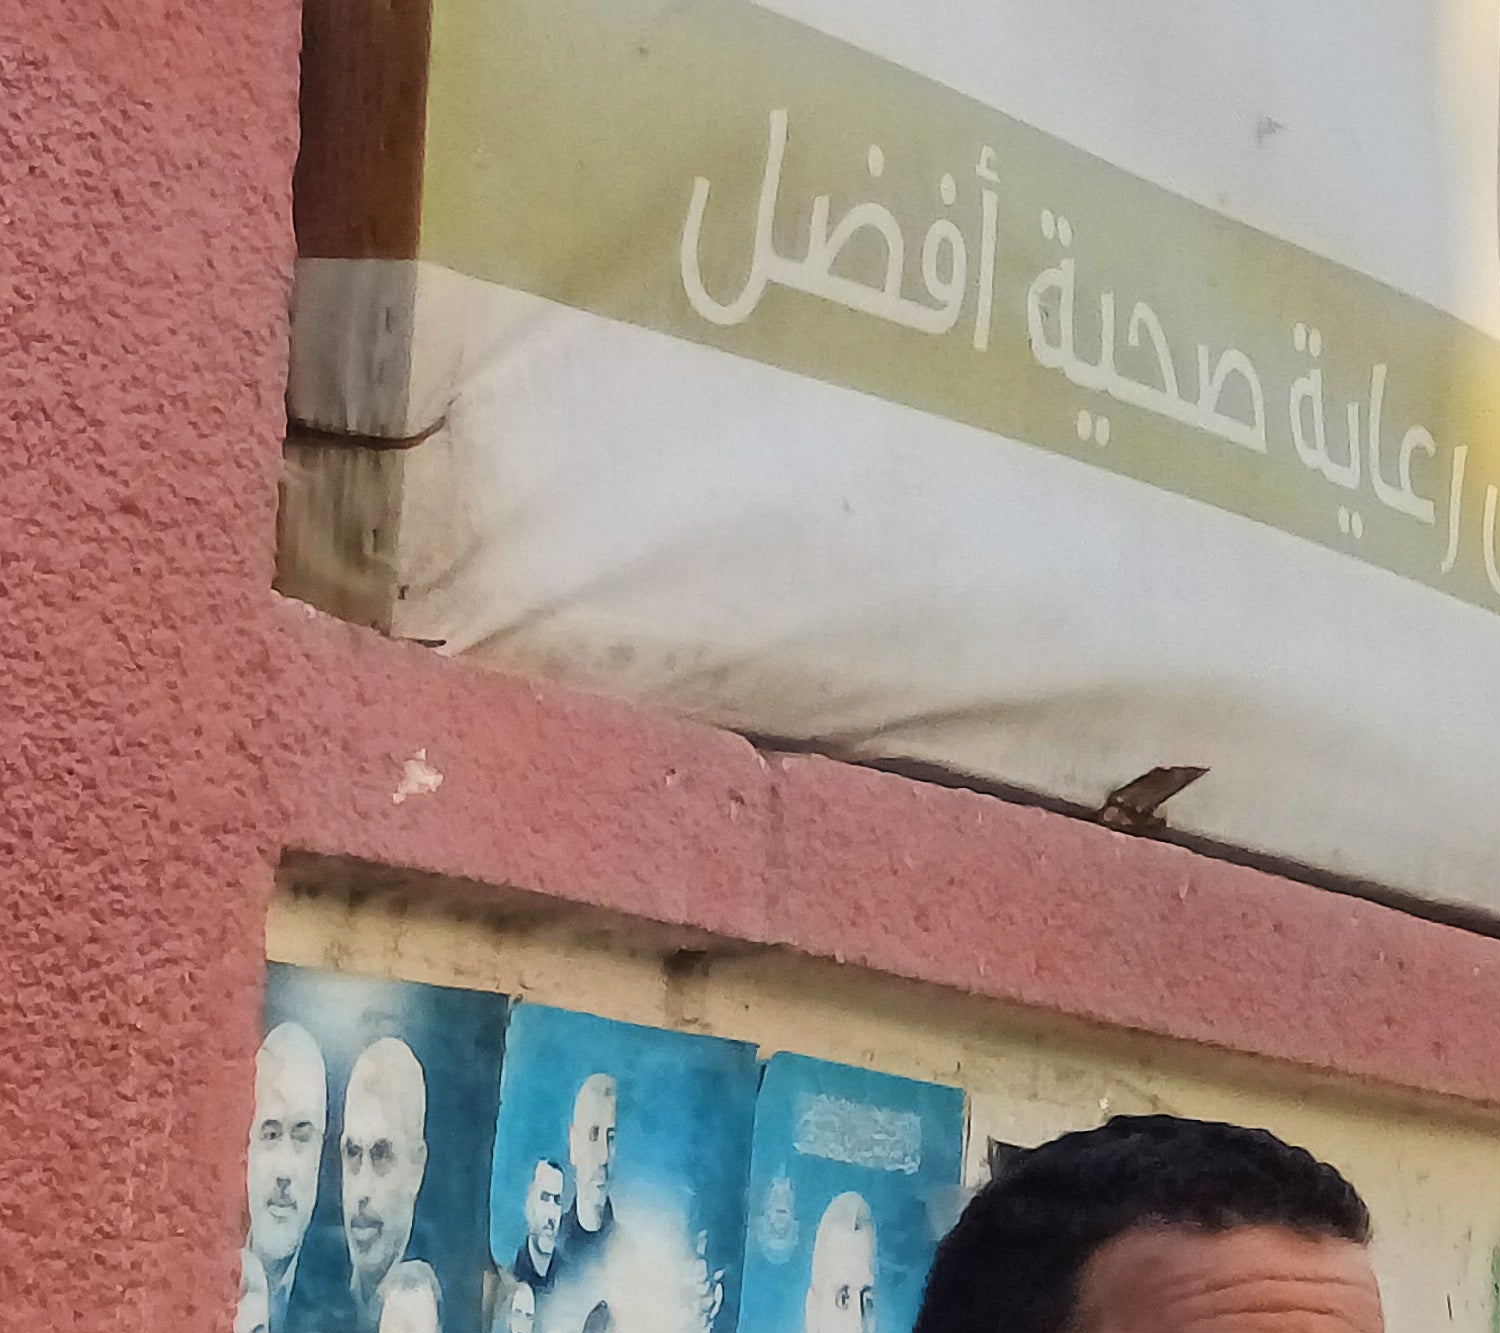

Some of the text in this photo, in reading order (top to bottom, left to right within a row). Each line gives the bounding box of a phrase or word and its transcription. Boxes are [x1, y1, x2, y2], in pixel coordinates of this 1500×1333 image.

[680, 108, 999, 354] أفضل
[1027, 208, 1268, 456] صحية
[1289, 321, 1469, 574] رعاية
